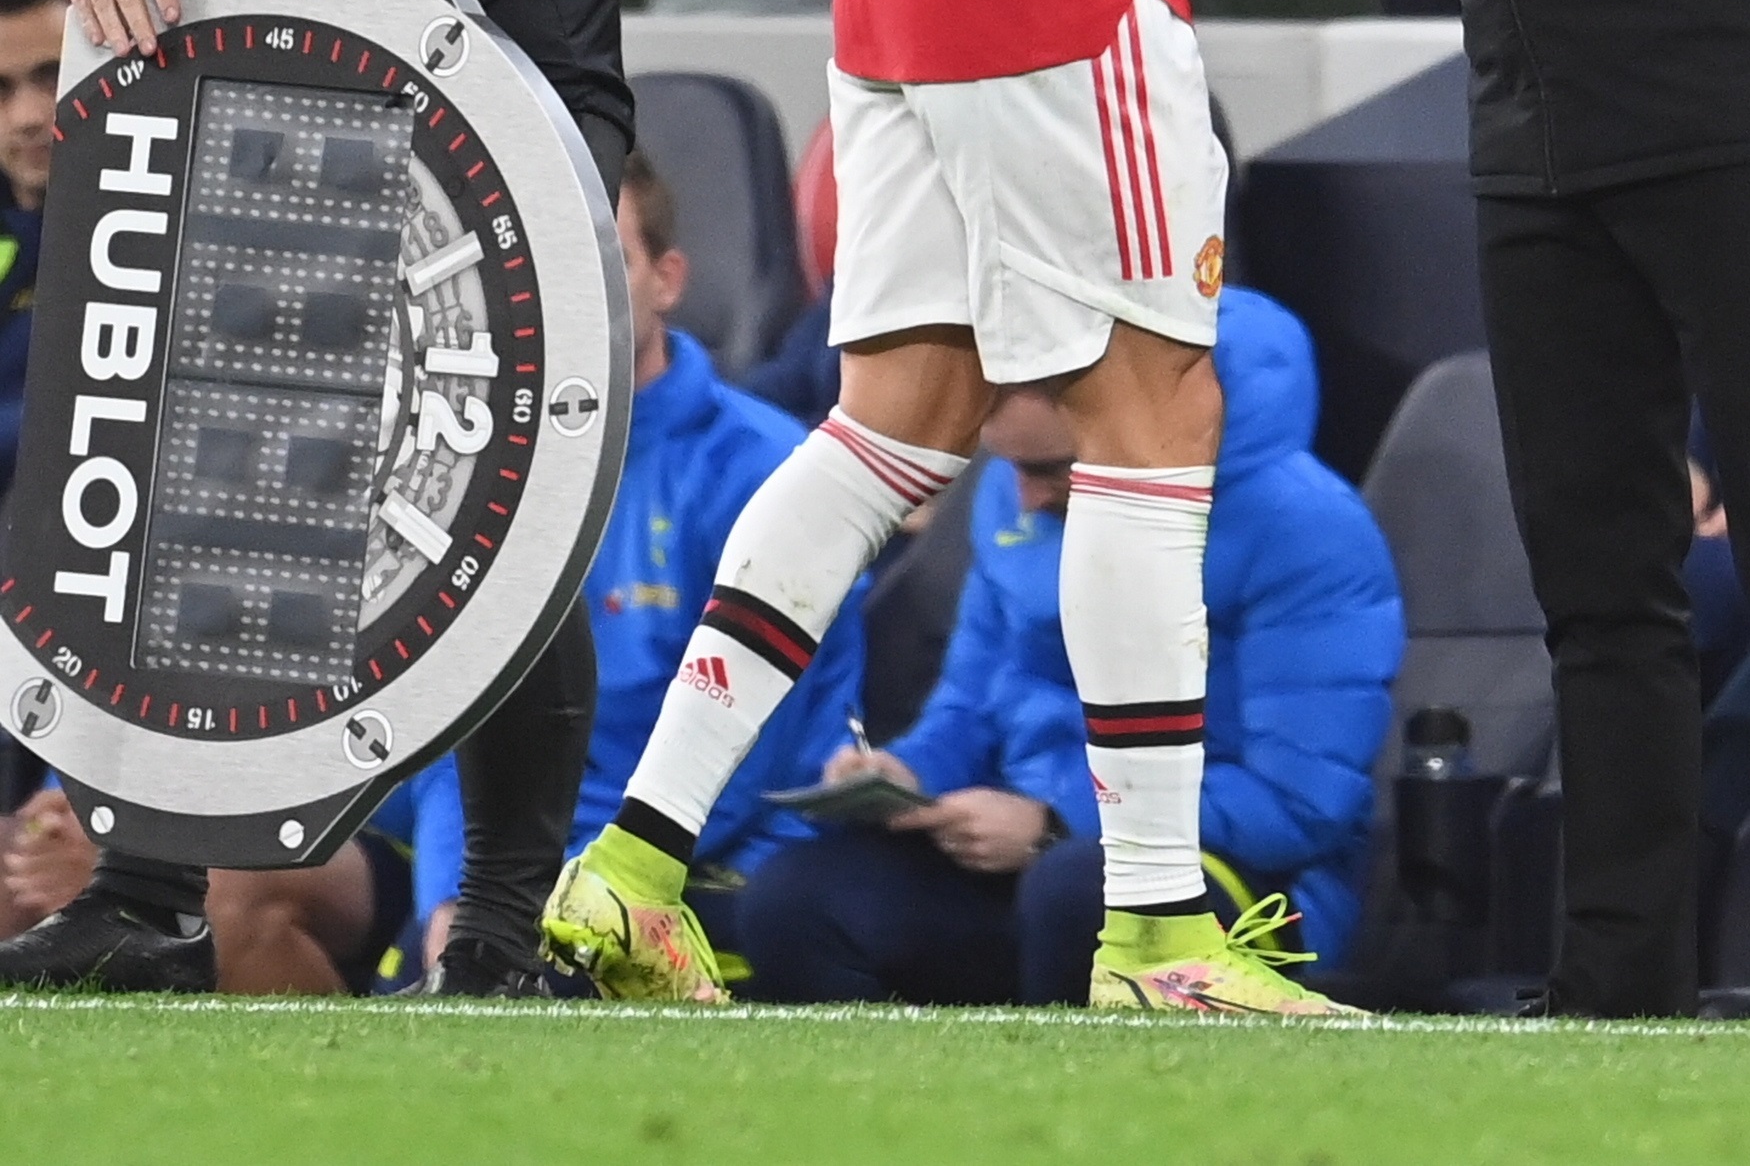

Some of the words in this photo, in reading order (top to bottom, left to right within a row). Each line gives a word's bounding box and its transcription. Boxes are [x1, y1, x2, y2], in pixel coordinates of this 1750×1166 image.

[265, 27, 294, 50] 45
[492, 214, 518, 251] 55
[54, 112, 179, 624] HUBLOT
[417, 331, 500, 455] 12
[512, 388, 534, 424] 60
[451, 555, 480, 591] 05
[52, 646, 82, 677] 20
[187, 707, 216, 731] 15
